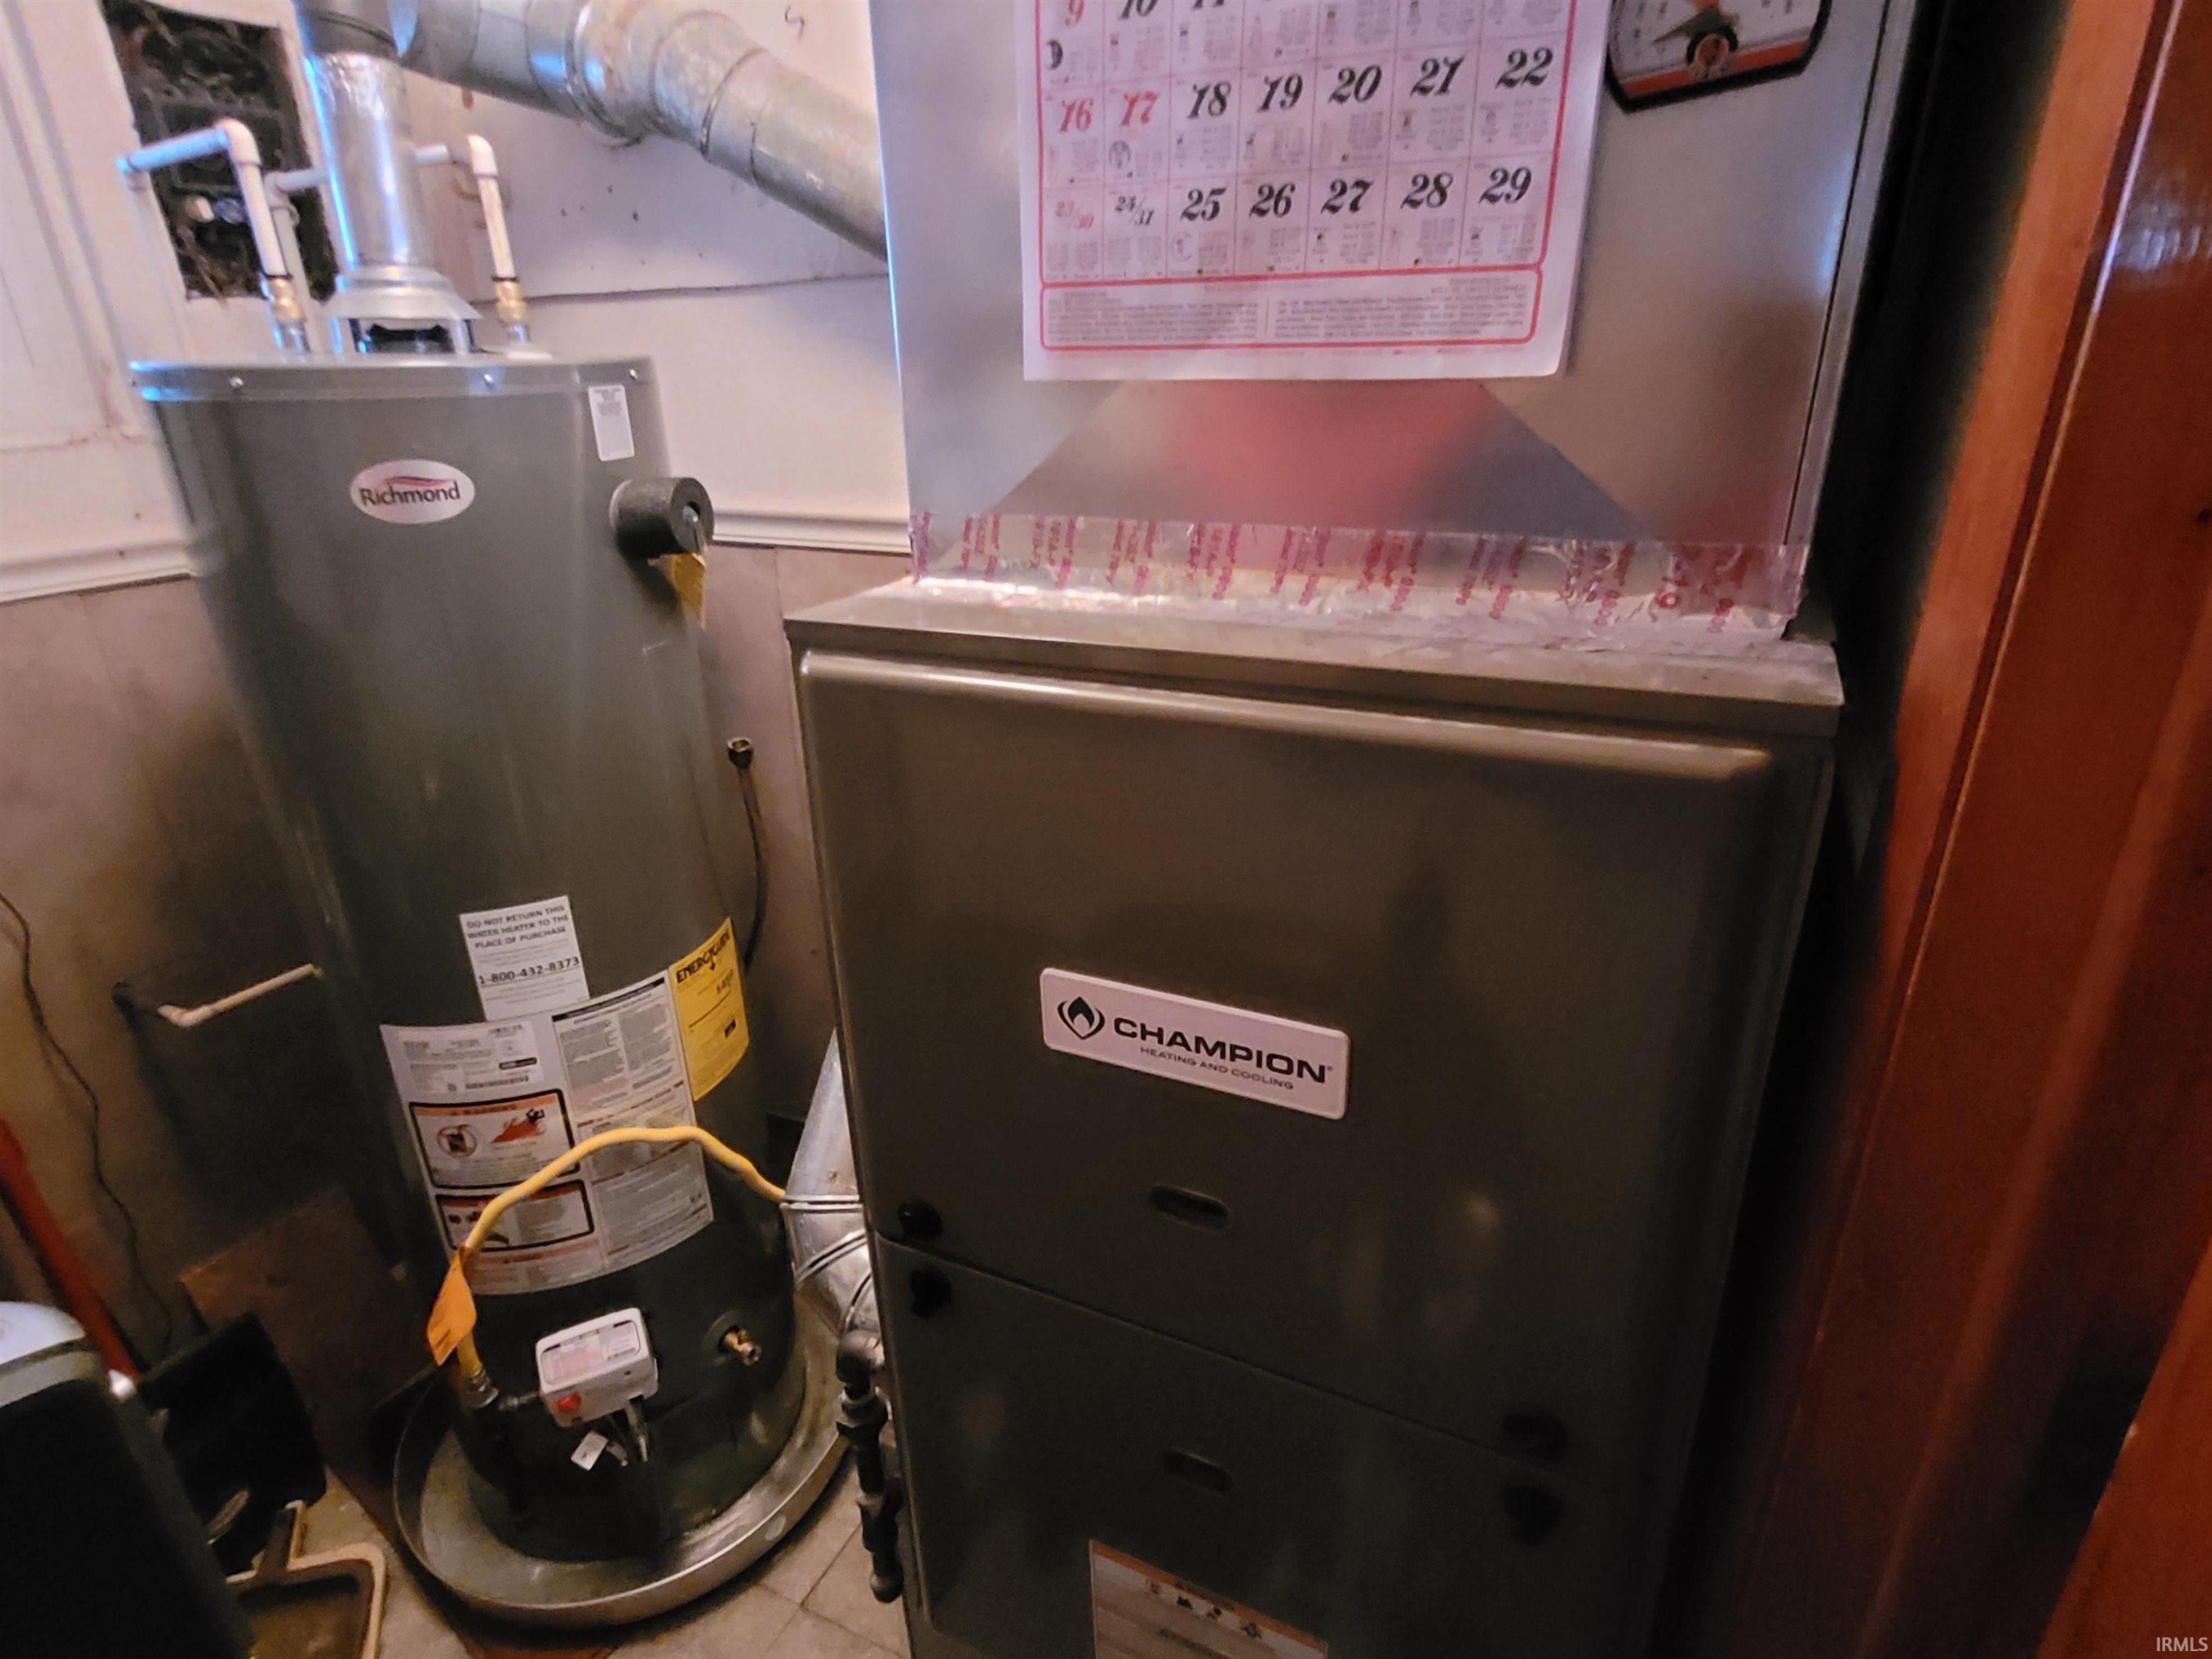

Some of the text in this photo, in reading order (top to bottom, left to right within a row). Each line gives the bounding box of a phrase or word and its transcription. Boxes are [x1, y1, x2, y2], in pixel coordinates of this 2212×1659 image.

[1064, 0, 1085, 27] 9
[1059, 46, 1554, 132] 16 17 18 19 20 21 22
[1180, 187, 1227, 222] 25
[1249, 183, 1297, 219] 26
[1321, 179, 1375, 215] 27
[1401, 171, 1454, 210] 28
[1479, 166, 1532, 204] 29
[360, 480, 460, 506] Richmond
[467, 905, 565, 929] DO NOT RETURN THIS
[468, 914, 570, 939] WATER HEATER TO THE
[475, 926, 567, 949] PLACE OF PURCHASE
[478, 956, 580, 984] 1-800-432-8373
[1114, 1017, 1326, 1084] CHAMPION
[1140, 1046, 1294, 1090] HEATING AND COOLING
